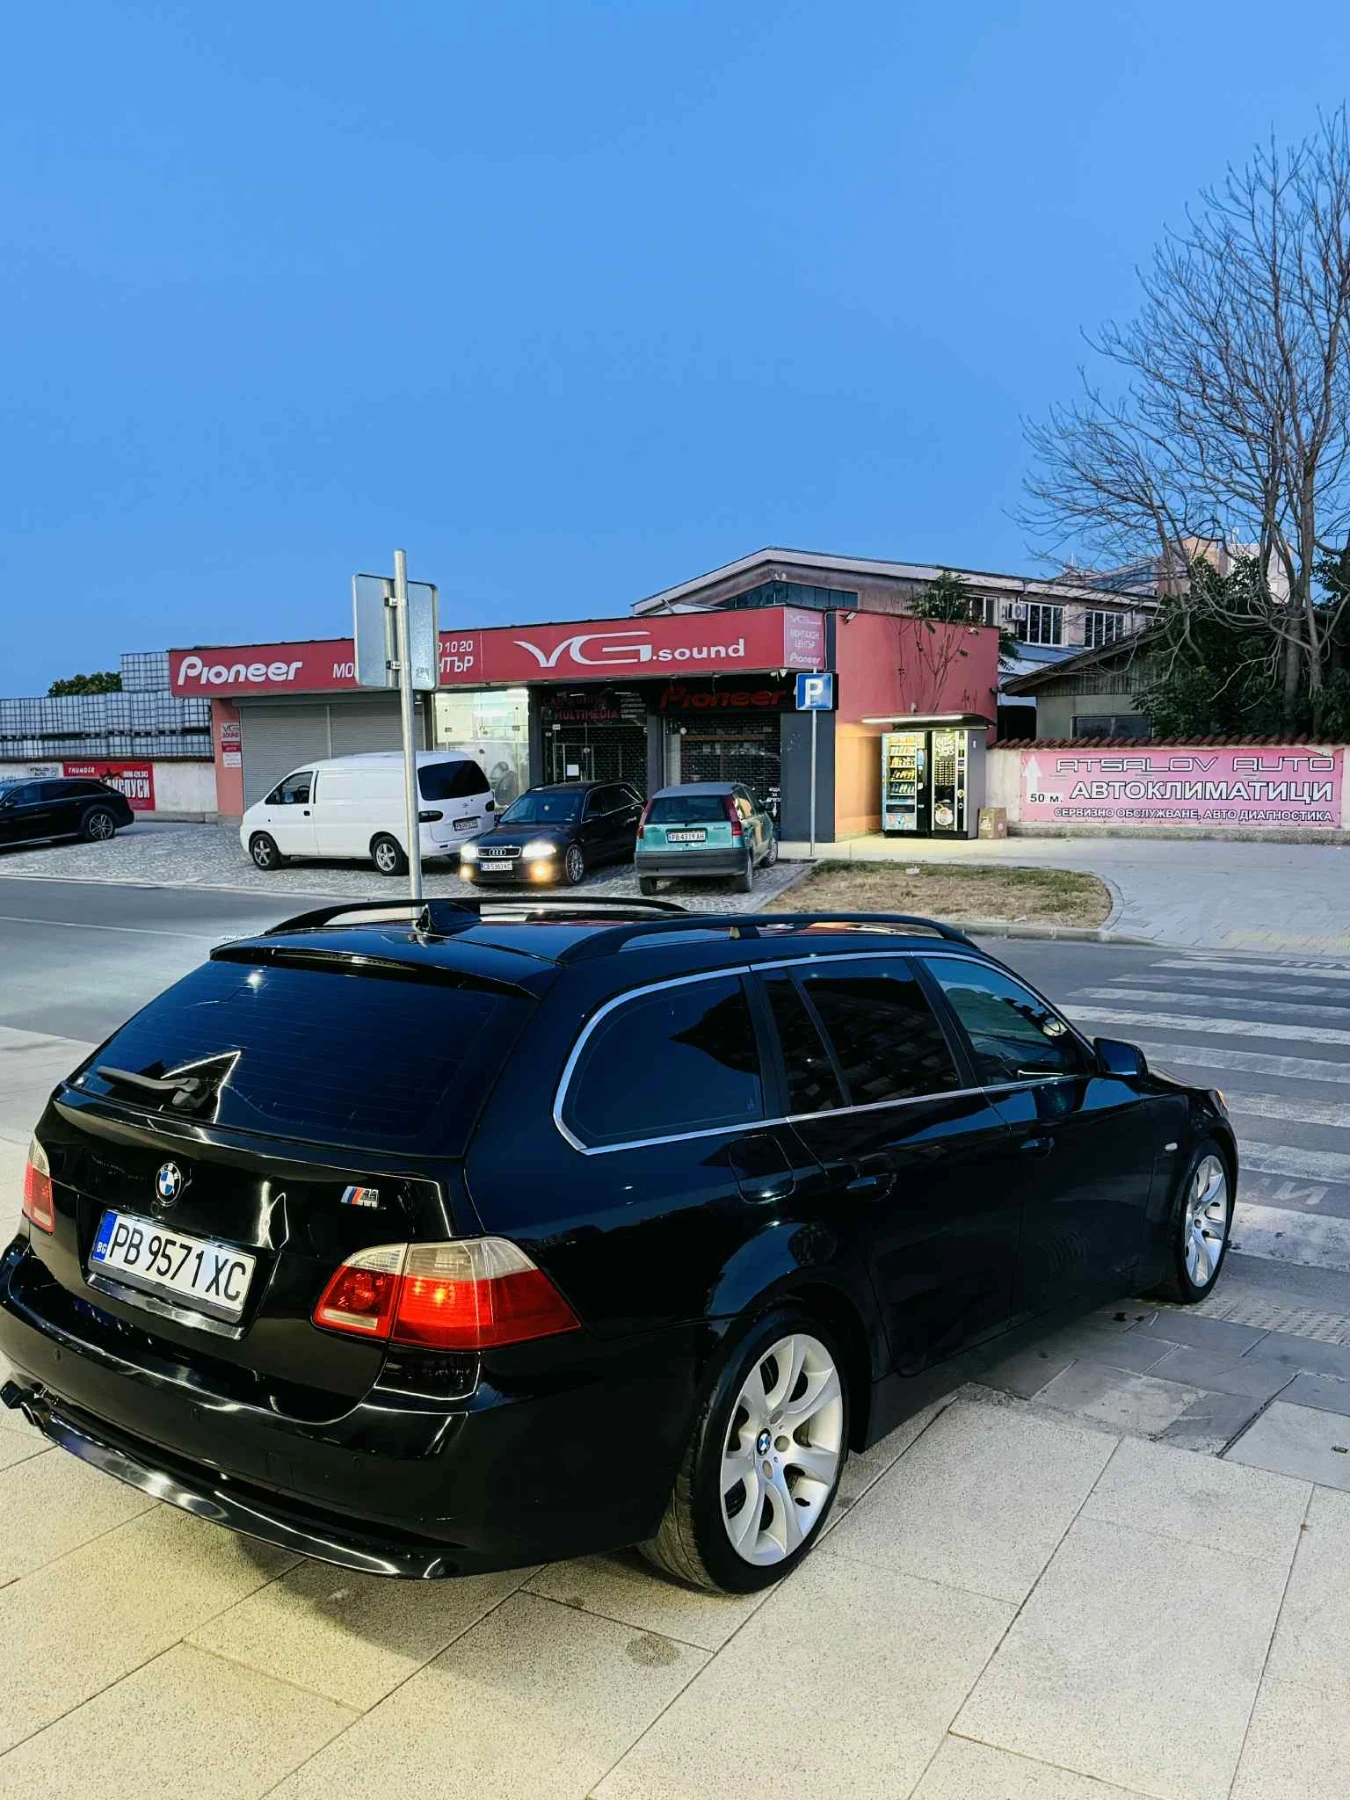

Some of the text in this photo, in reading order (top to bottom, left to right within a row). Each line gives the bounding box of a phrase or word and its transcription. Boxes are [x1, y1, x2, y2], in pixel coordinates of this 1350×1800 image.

[445, 641, 458, 653] 10
[459, 640, 474, 652] 20
[177, 655, 303, 685] Pioneer
[659, 684, 786, 711] Pioneer
[804, 678, 824, 705] P
[1056, 756, 1335, 773] ATSALOV AUTO
[1030, 793, 1045, 803] 50
[1069, 780, 1334, 805] АВТОКЛИМАТИЦИ
[1054, 807, 1334, 822] СЕРВИЗНО ОБСЛУЖВАНЕ, АВТО ДИАГНОСТИКА
[97, 1241, 108, 1254] BG
[109, 1223, 246, 1302] PB 9571 XC
